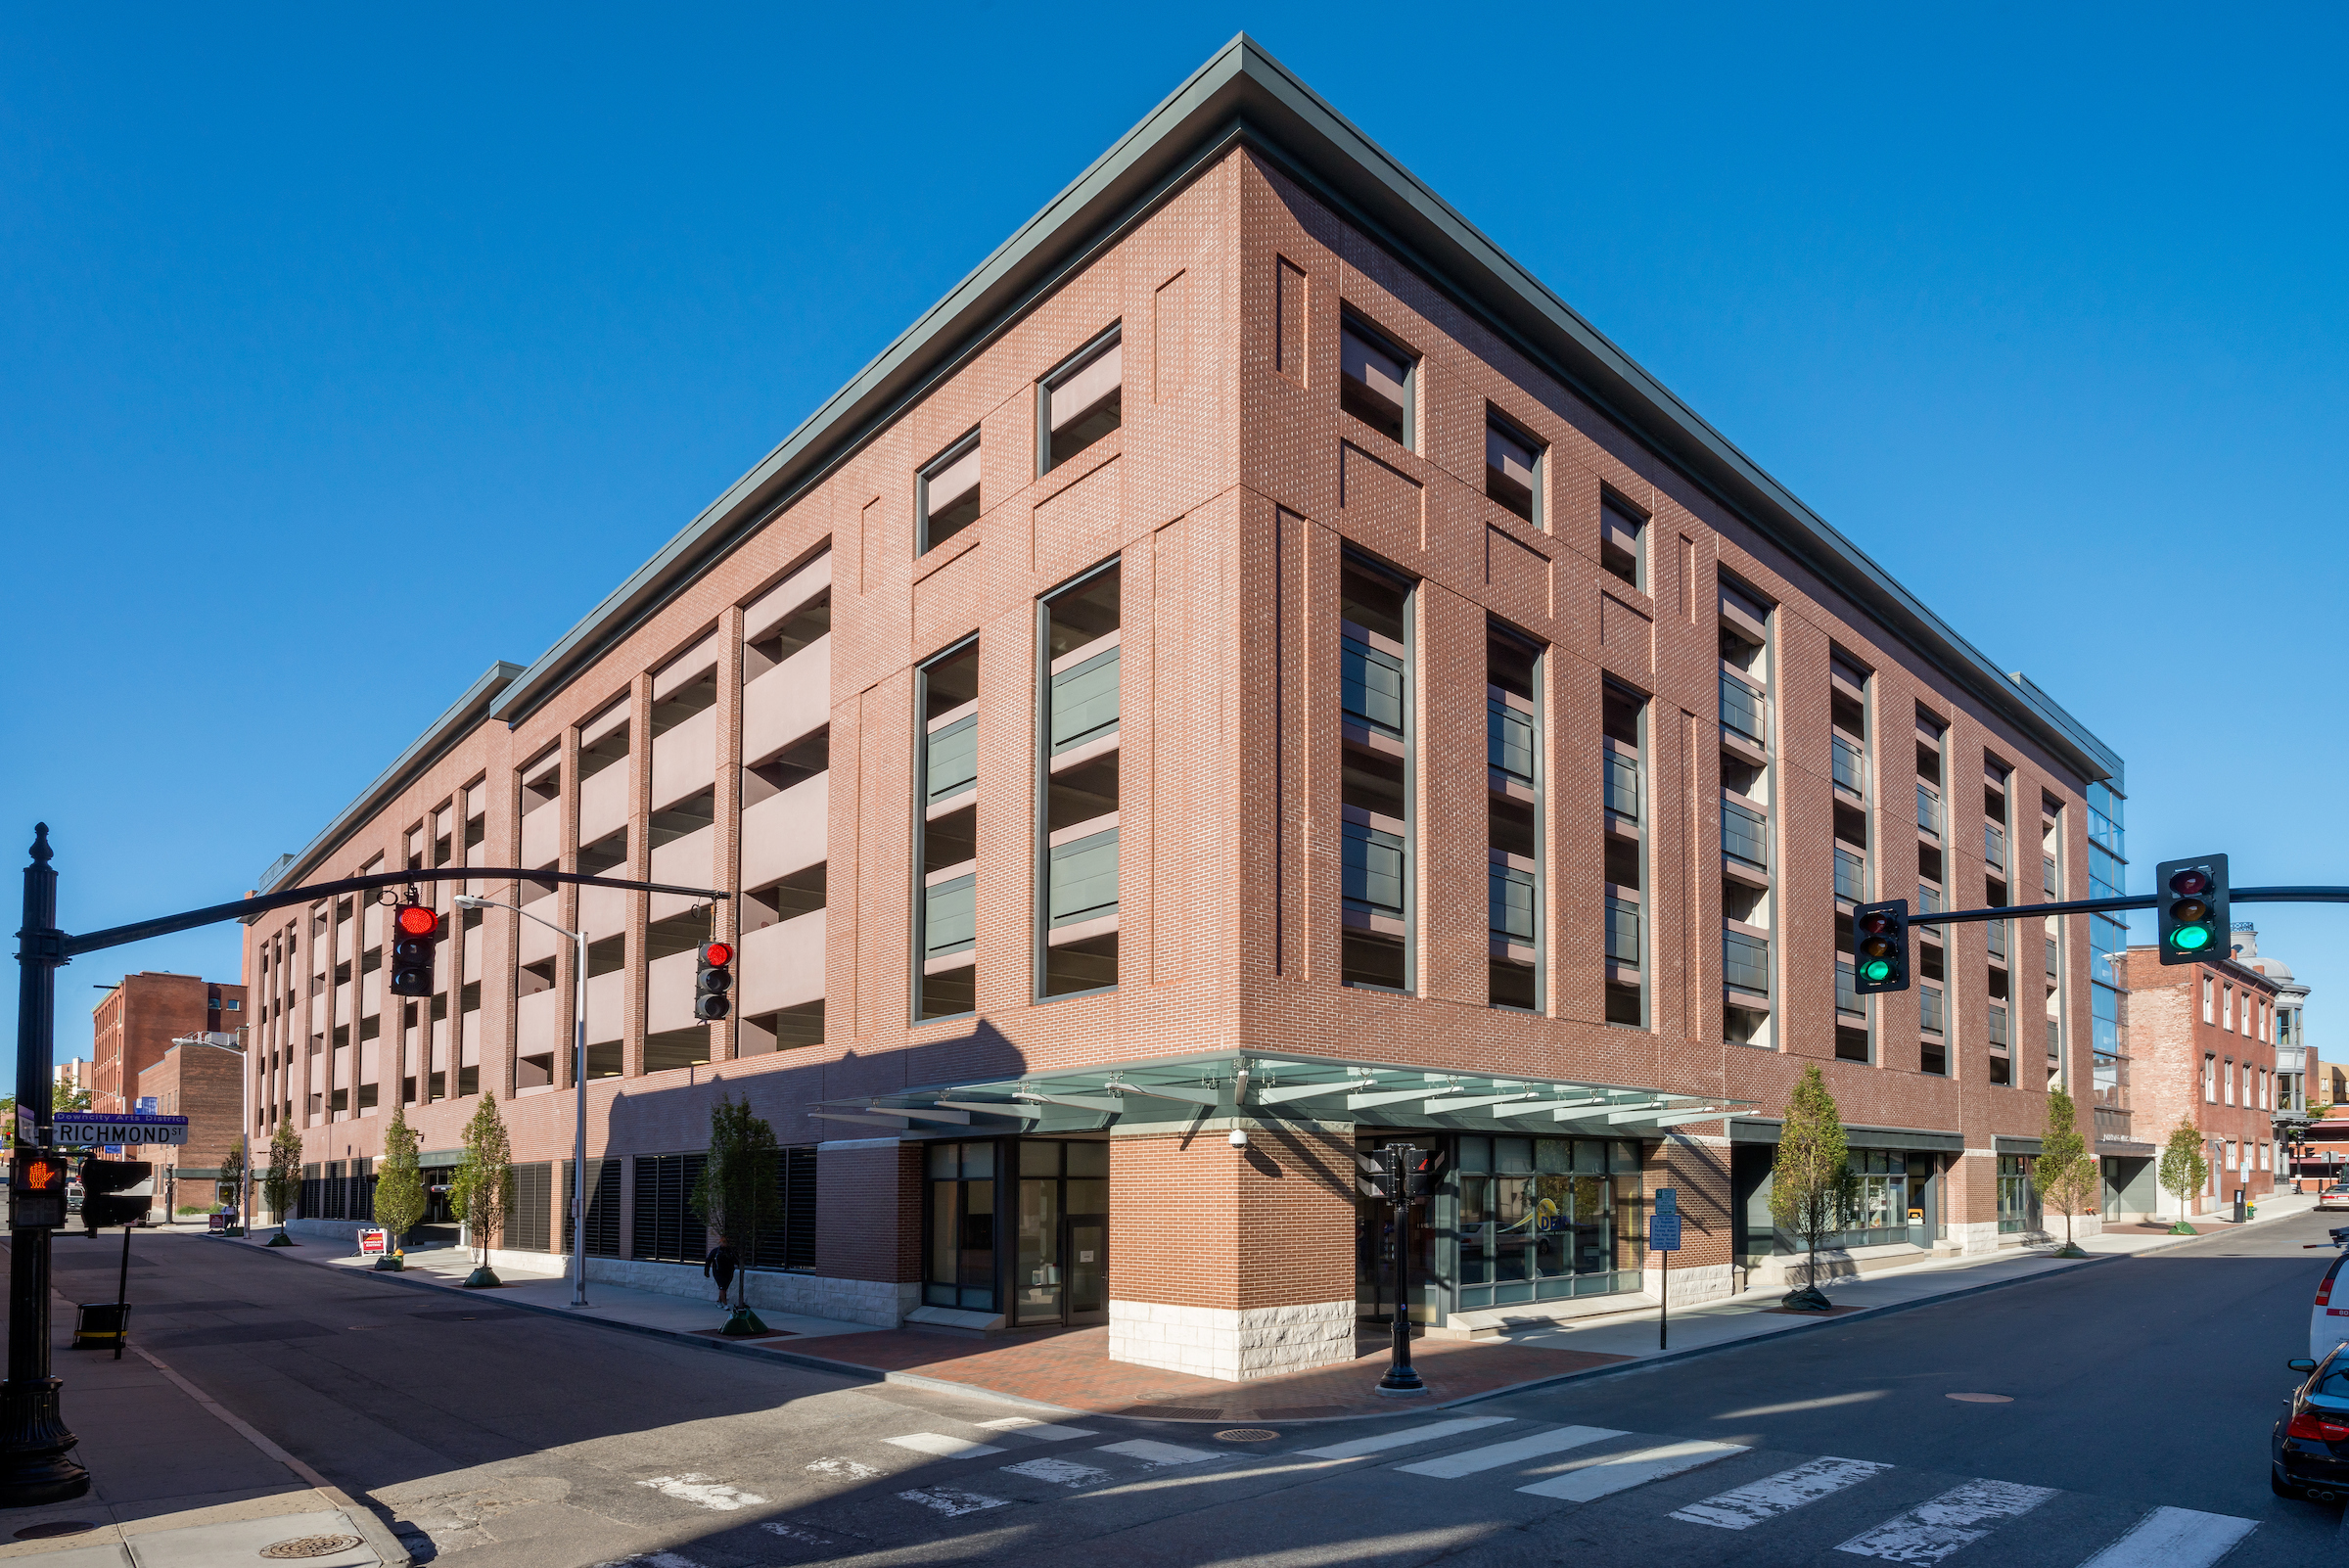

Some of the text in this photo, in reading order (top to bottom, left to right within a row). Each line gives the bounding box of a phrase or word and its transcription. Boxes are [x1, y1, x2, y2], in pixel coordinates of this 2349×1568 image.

[57, 1113, 110, 1121] Downcity
[60, 1125, 182, 1143] RICHMOND ST
